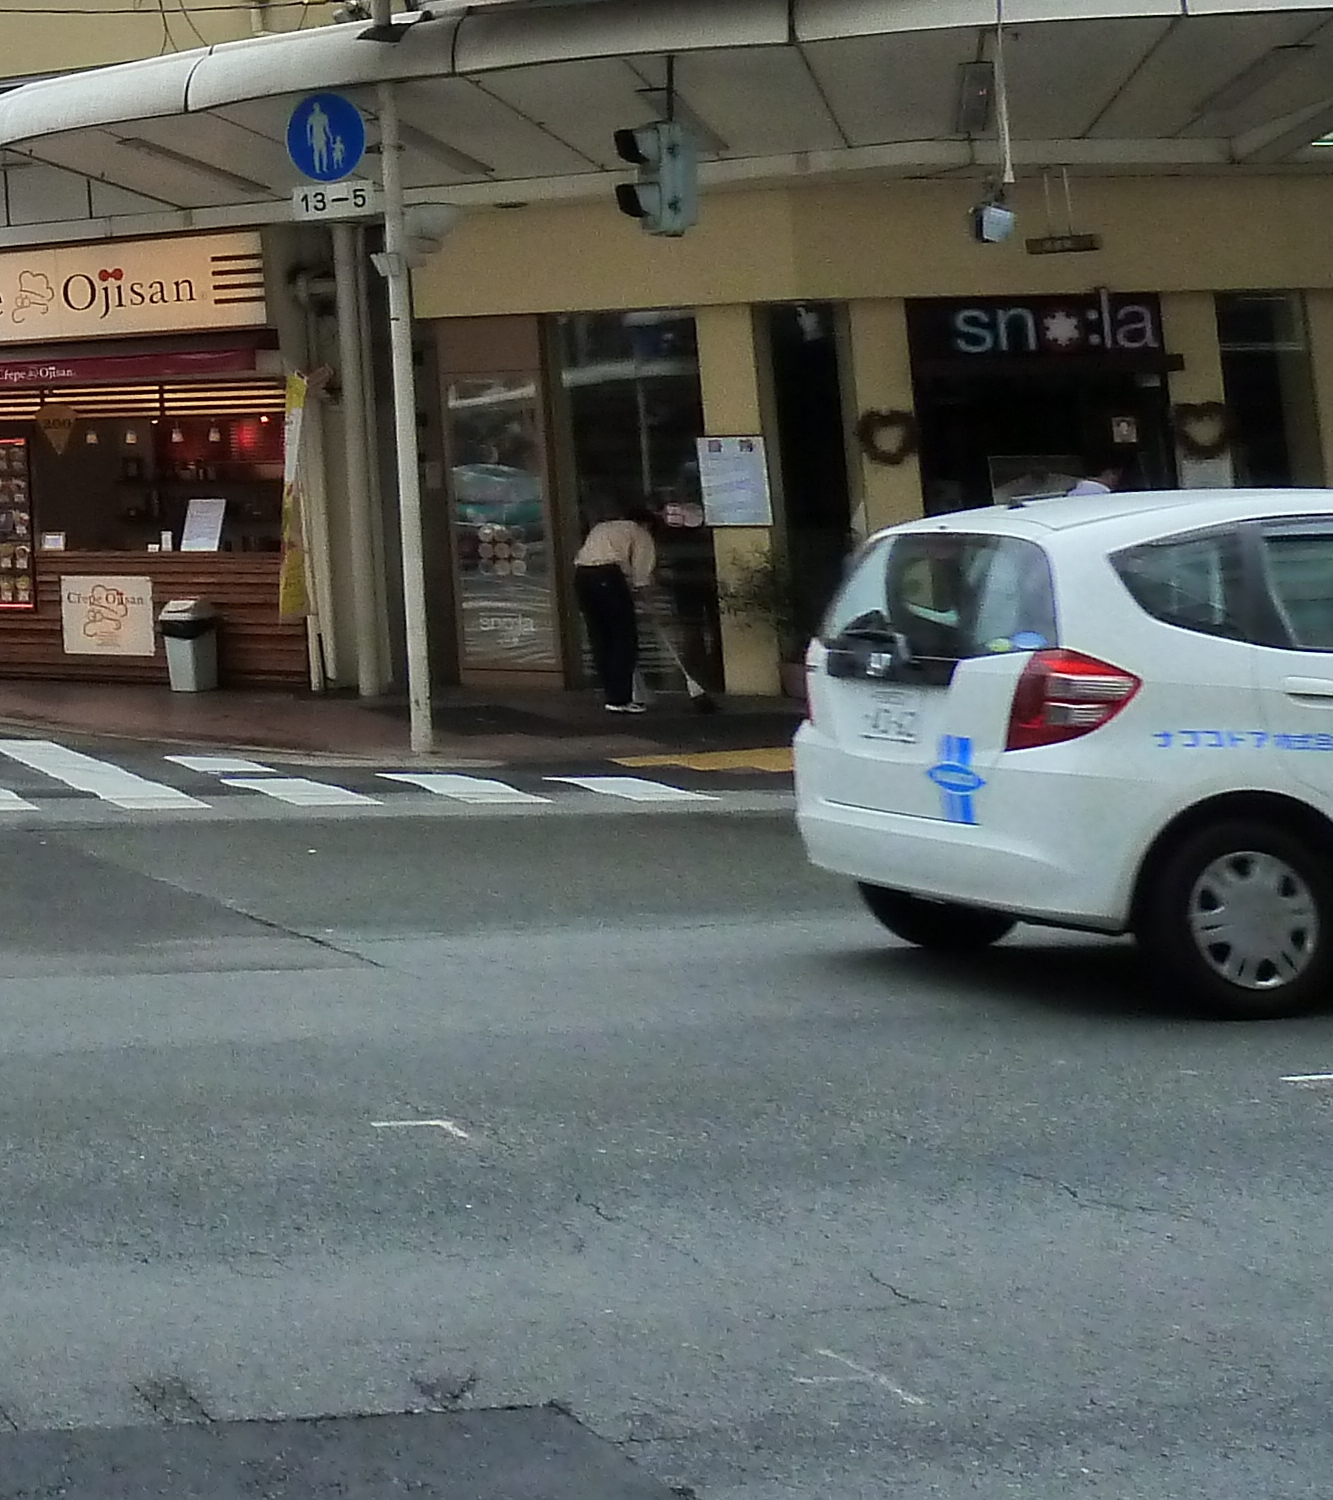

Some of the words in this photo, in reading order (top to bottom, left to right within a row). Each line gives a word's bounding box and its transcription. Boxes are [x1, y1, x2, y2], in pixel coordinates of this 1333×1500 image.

[299, 188, 367, 213] 13-5
[62, 269, 197, 319] Ojisan
[39, 366, 73, 380] Ojisan
